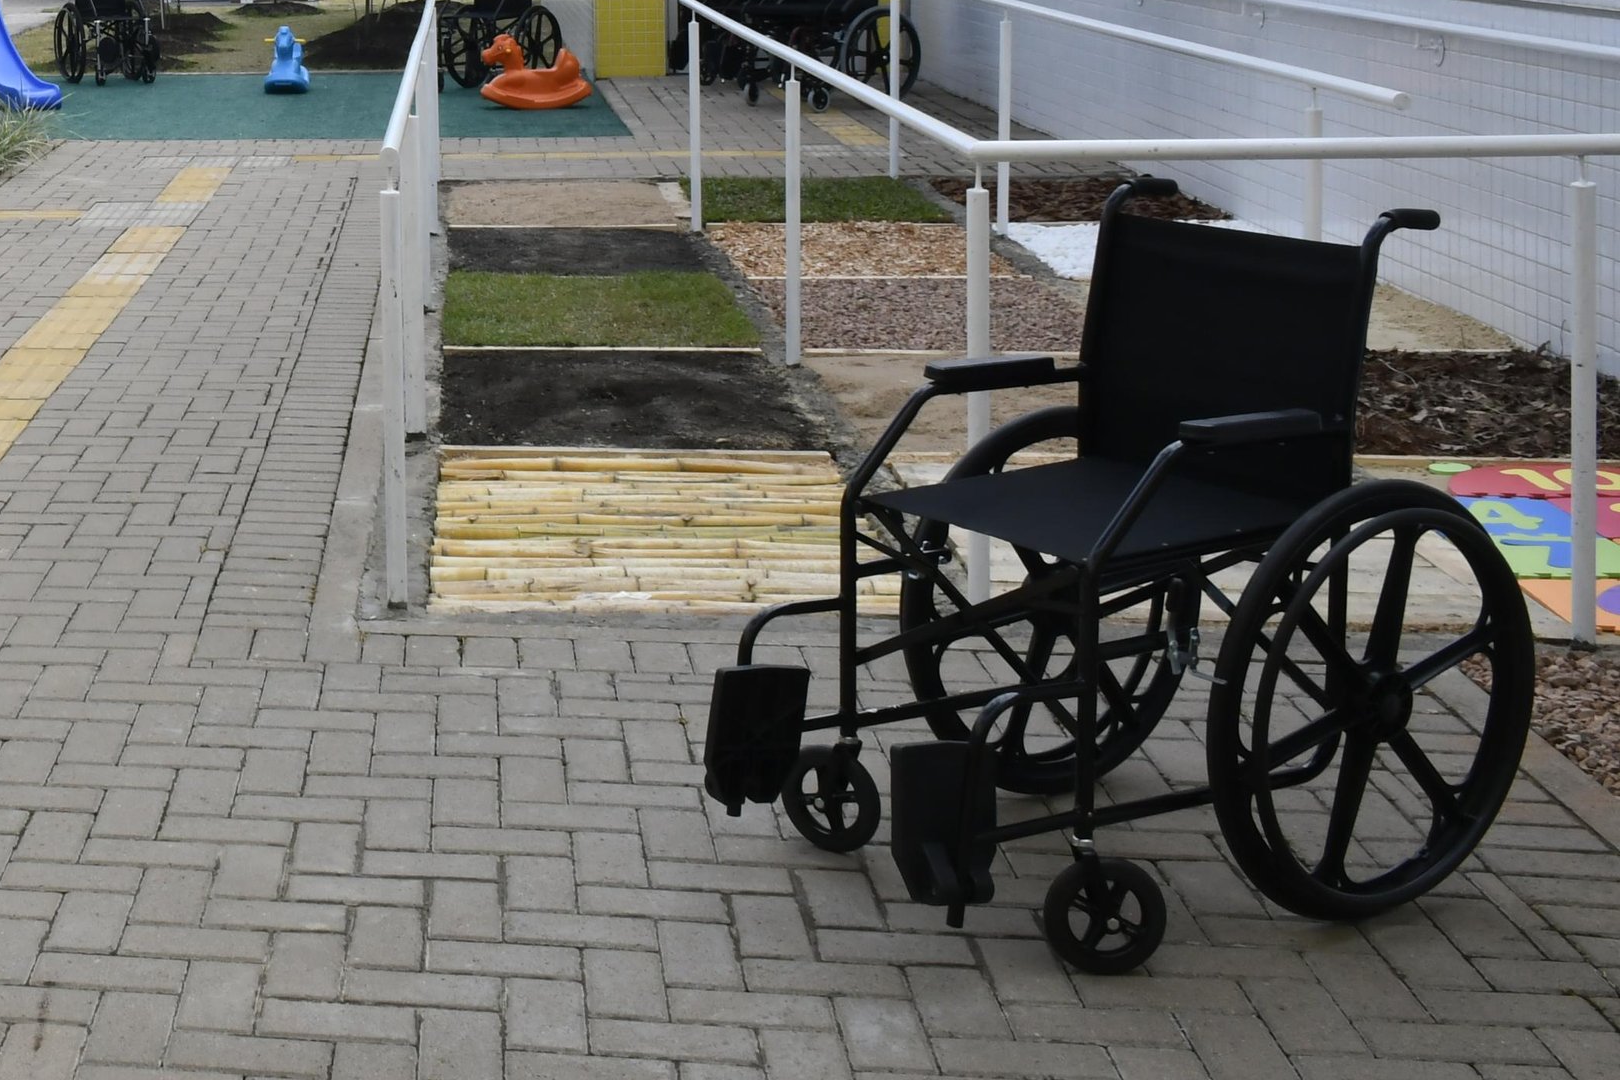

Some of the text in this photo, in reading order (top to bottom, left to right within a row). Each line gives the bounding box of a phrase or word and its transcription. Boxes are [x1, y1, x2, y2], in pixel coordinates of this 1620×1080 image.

[1498, 468, 1620, 491] 10
[1466, 499, 1545, 531] 4
[1499, 538, 1575, 569] 7
